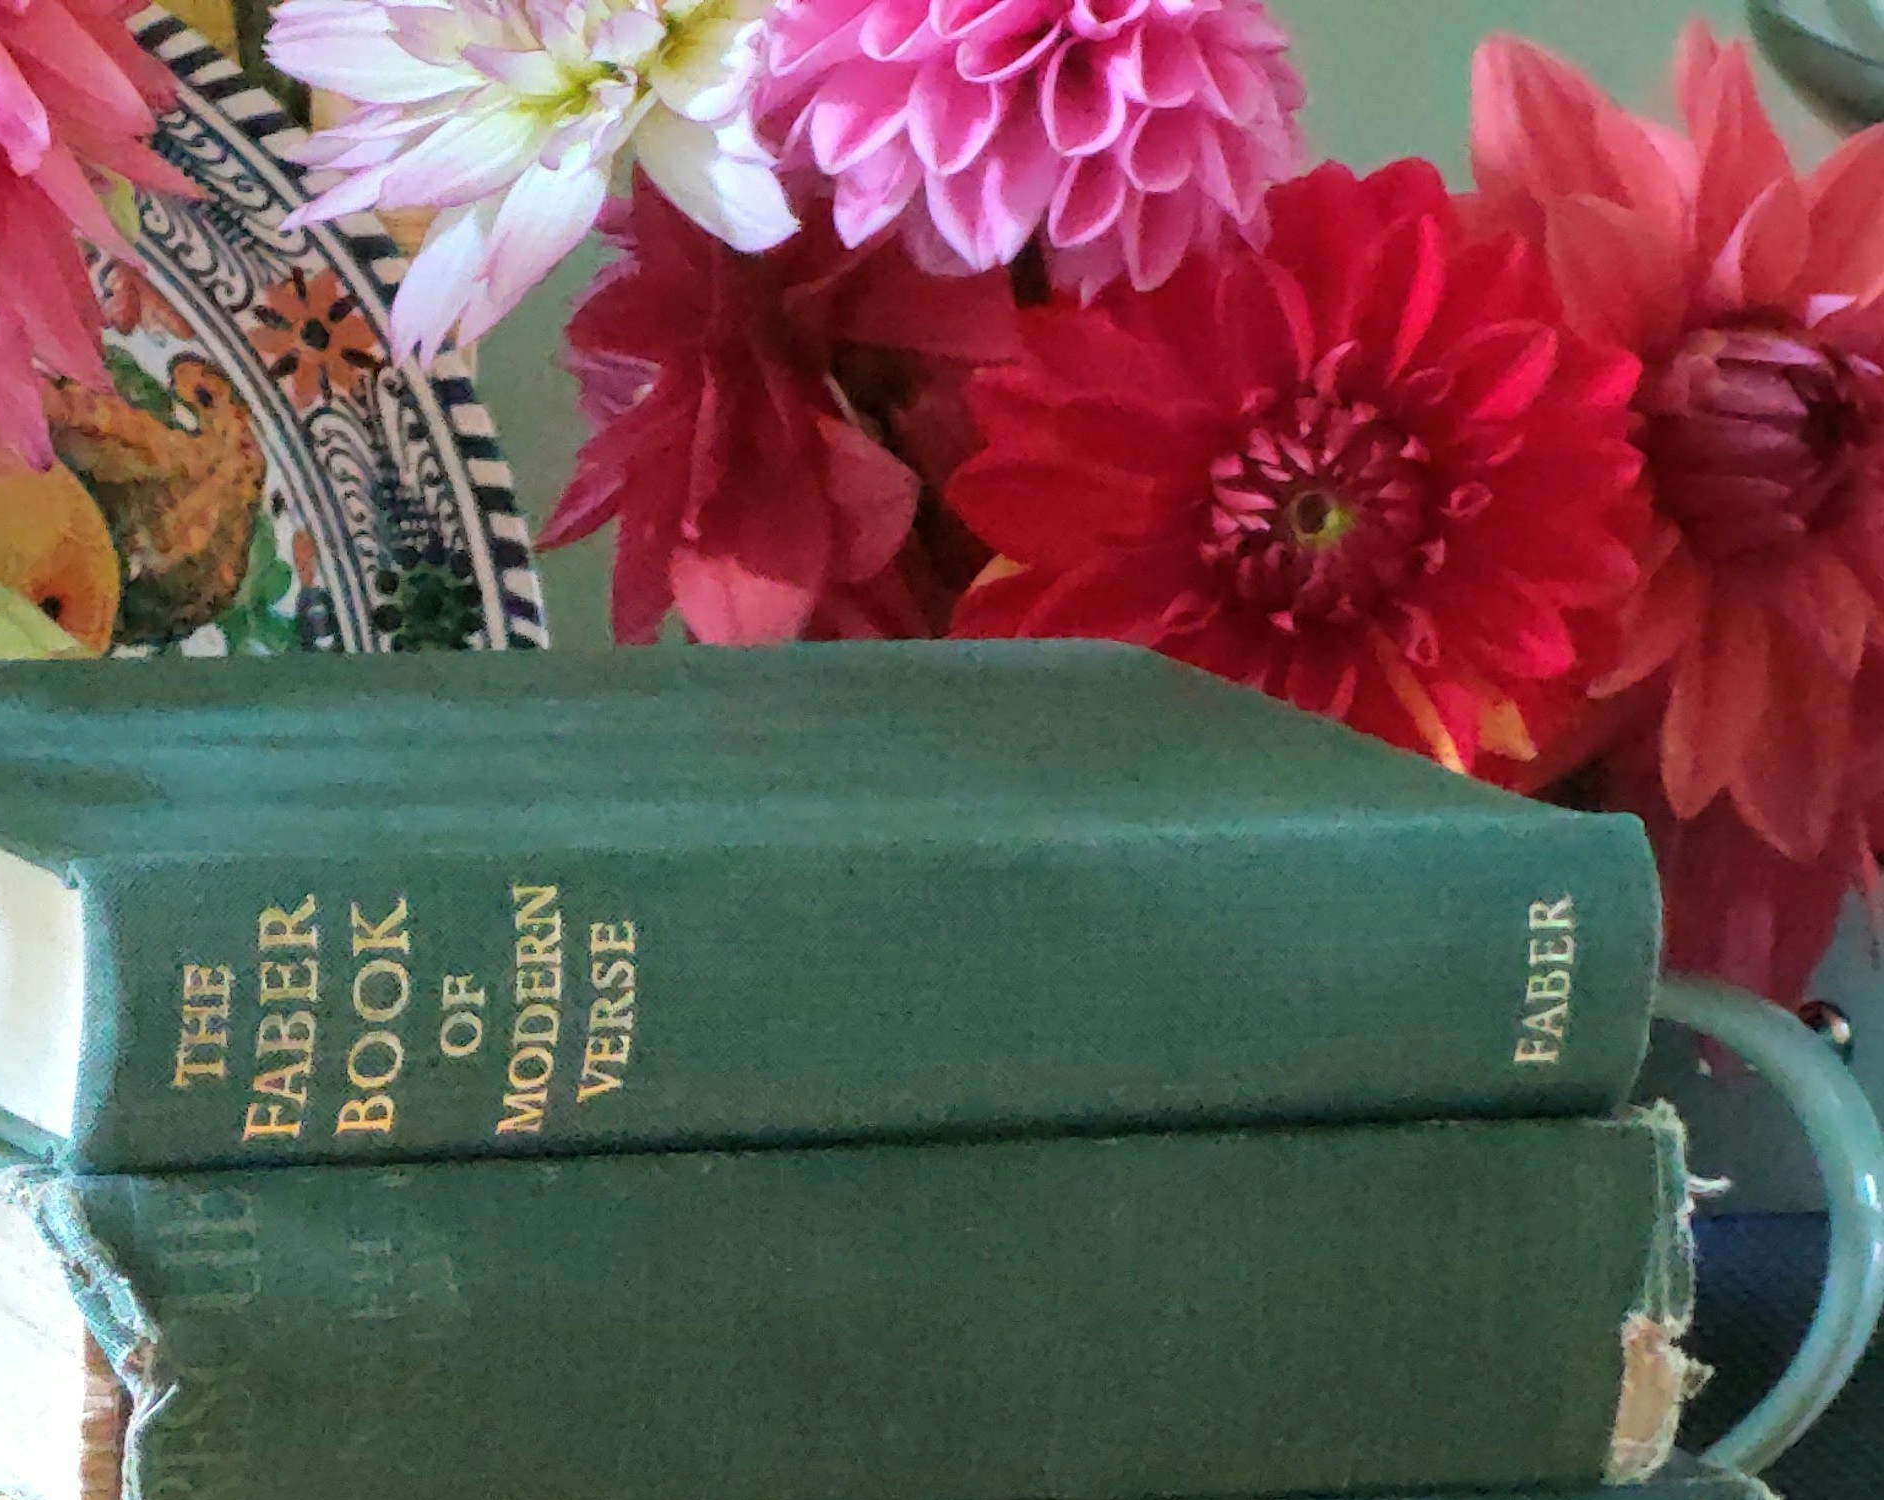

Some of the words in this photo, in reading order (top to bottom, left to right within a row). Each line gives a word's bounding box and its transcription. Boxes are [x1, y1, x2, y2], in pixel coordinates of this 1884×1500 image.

[173, 964, 235, 1088] THE
[242, 894, 319, 1141] FABER
[335, 898, 410, 1135] BOOK
[440, 975, 485, 1057] OF
[496, 886, 562, 1134] MODERN
[576, 921, 636, 1103] VERSE
[1514, 893, 1575, 1064] FABER
